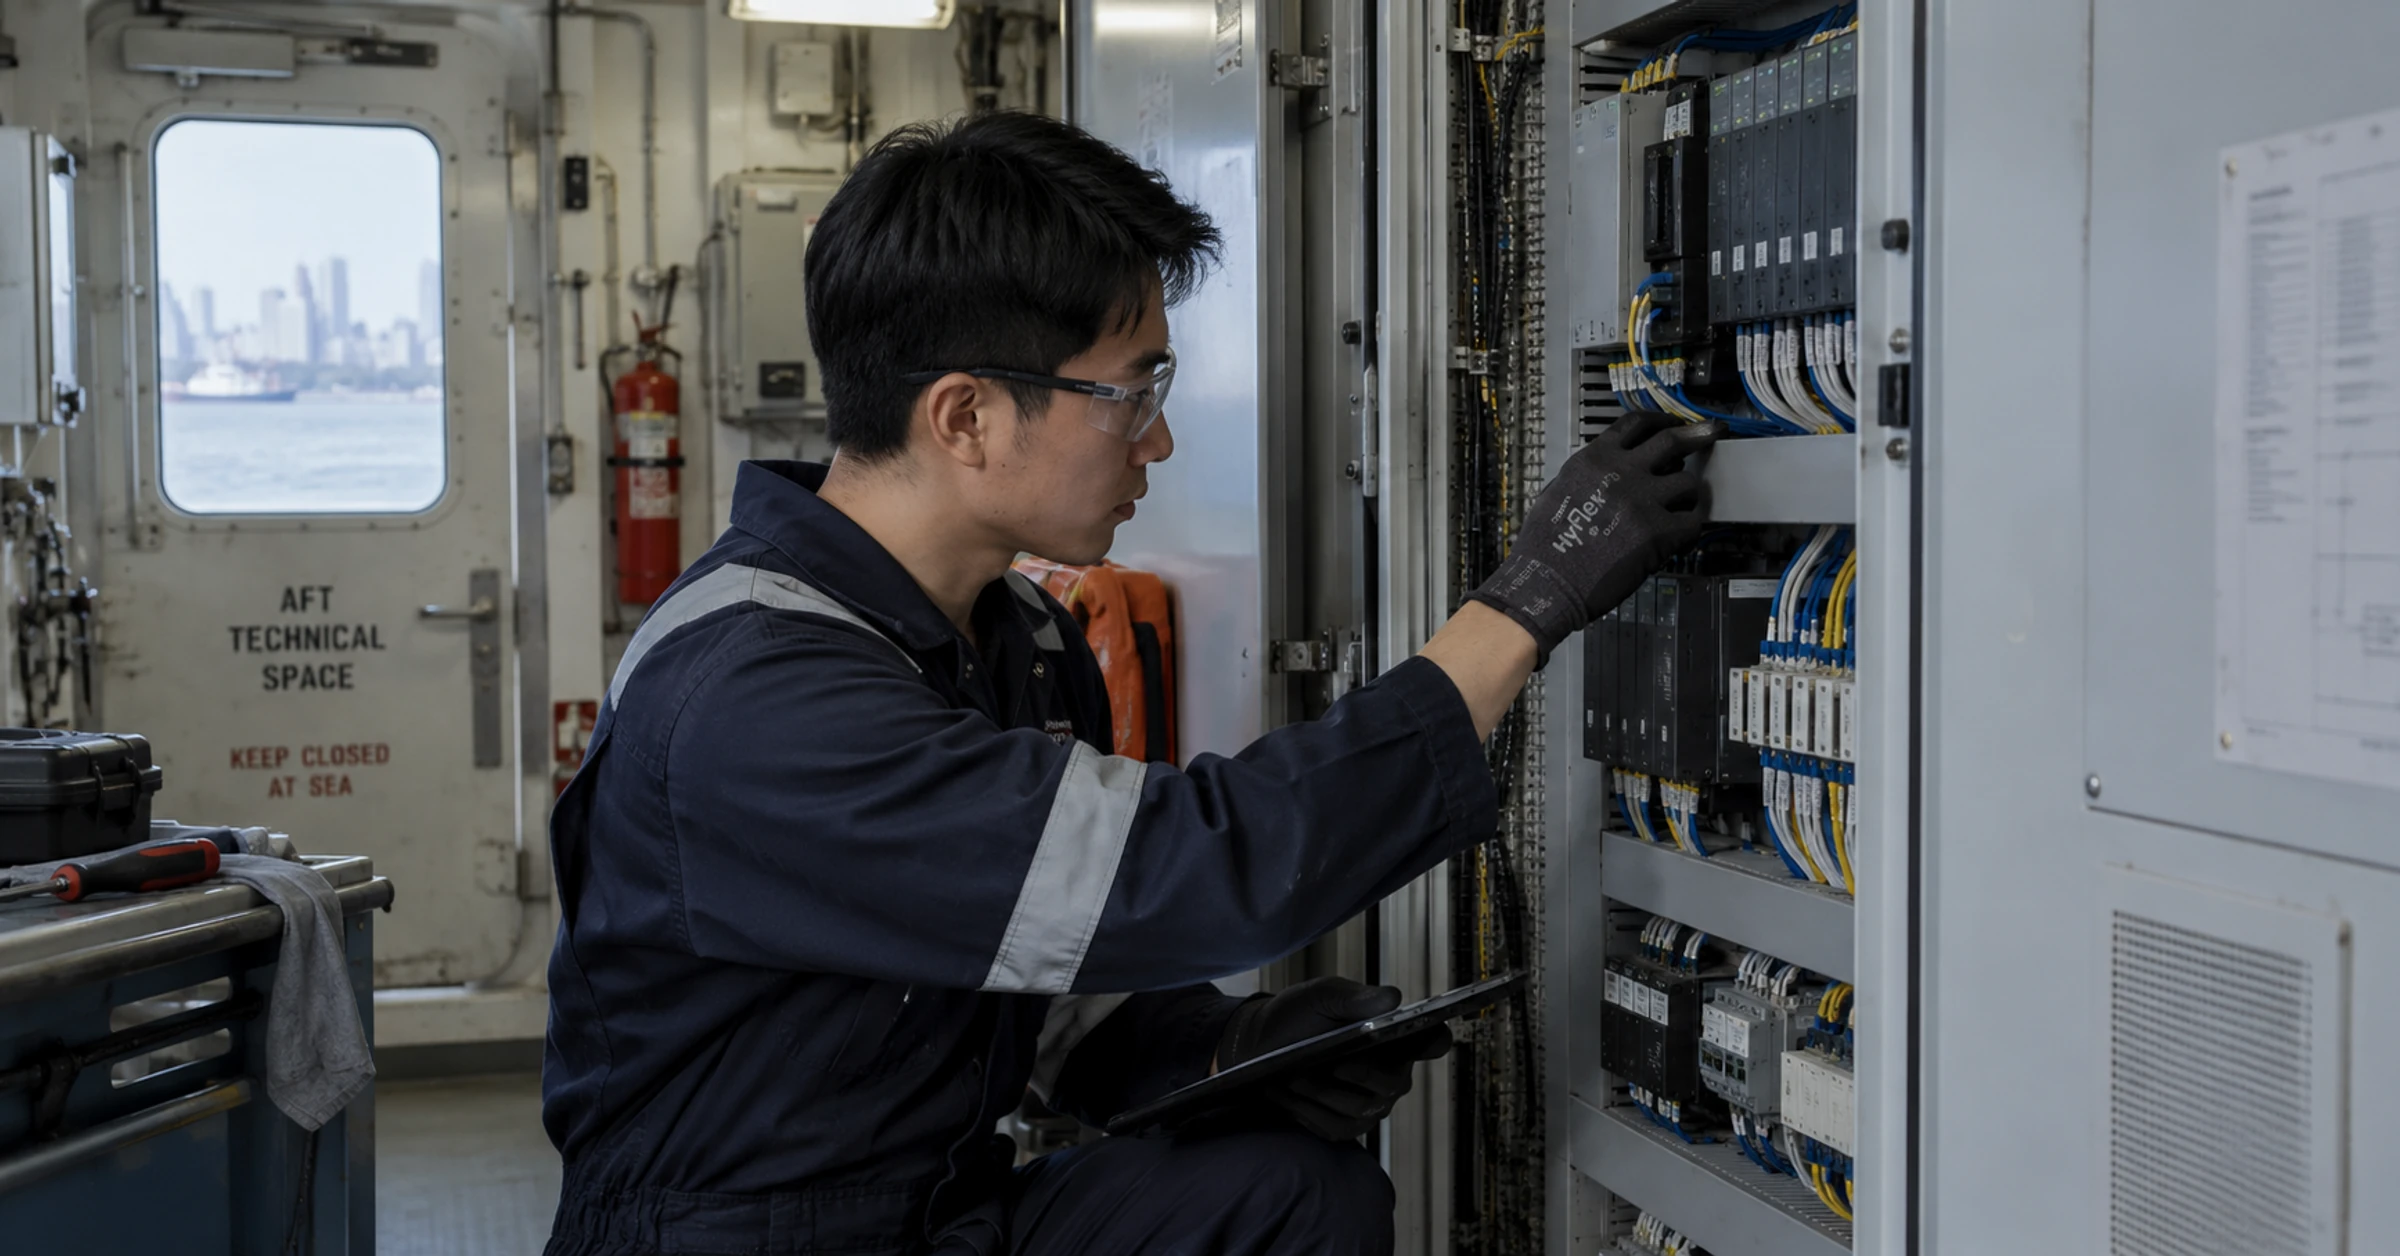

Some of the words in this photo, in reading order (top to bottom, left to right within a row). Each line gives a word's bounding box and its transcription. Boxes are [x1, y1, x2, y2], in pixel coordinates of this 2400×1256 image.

[280, 585, 333, 613] AFT
[229, 624, 386, 653] TECHNICAL
[262, 663, 354, 691] SPACE
[230, 746, 289, 769] KEEP
[301, 743, 390, 768] CLOSED
[268, 776, 296, 799] AT
[309, 774, 353, 797] SEA
